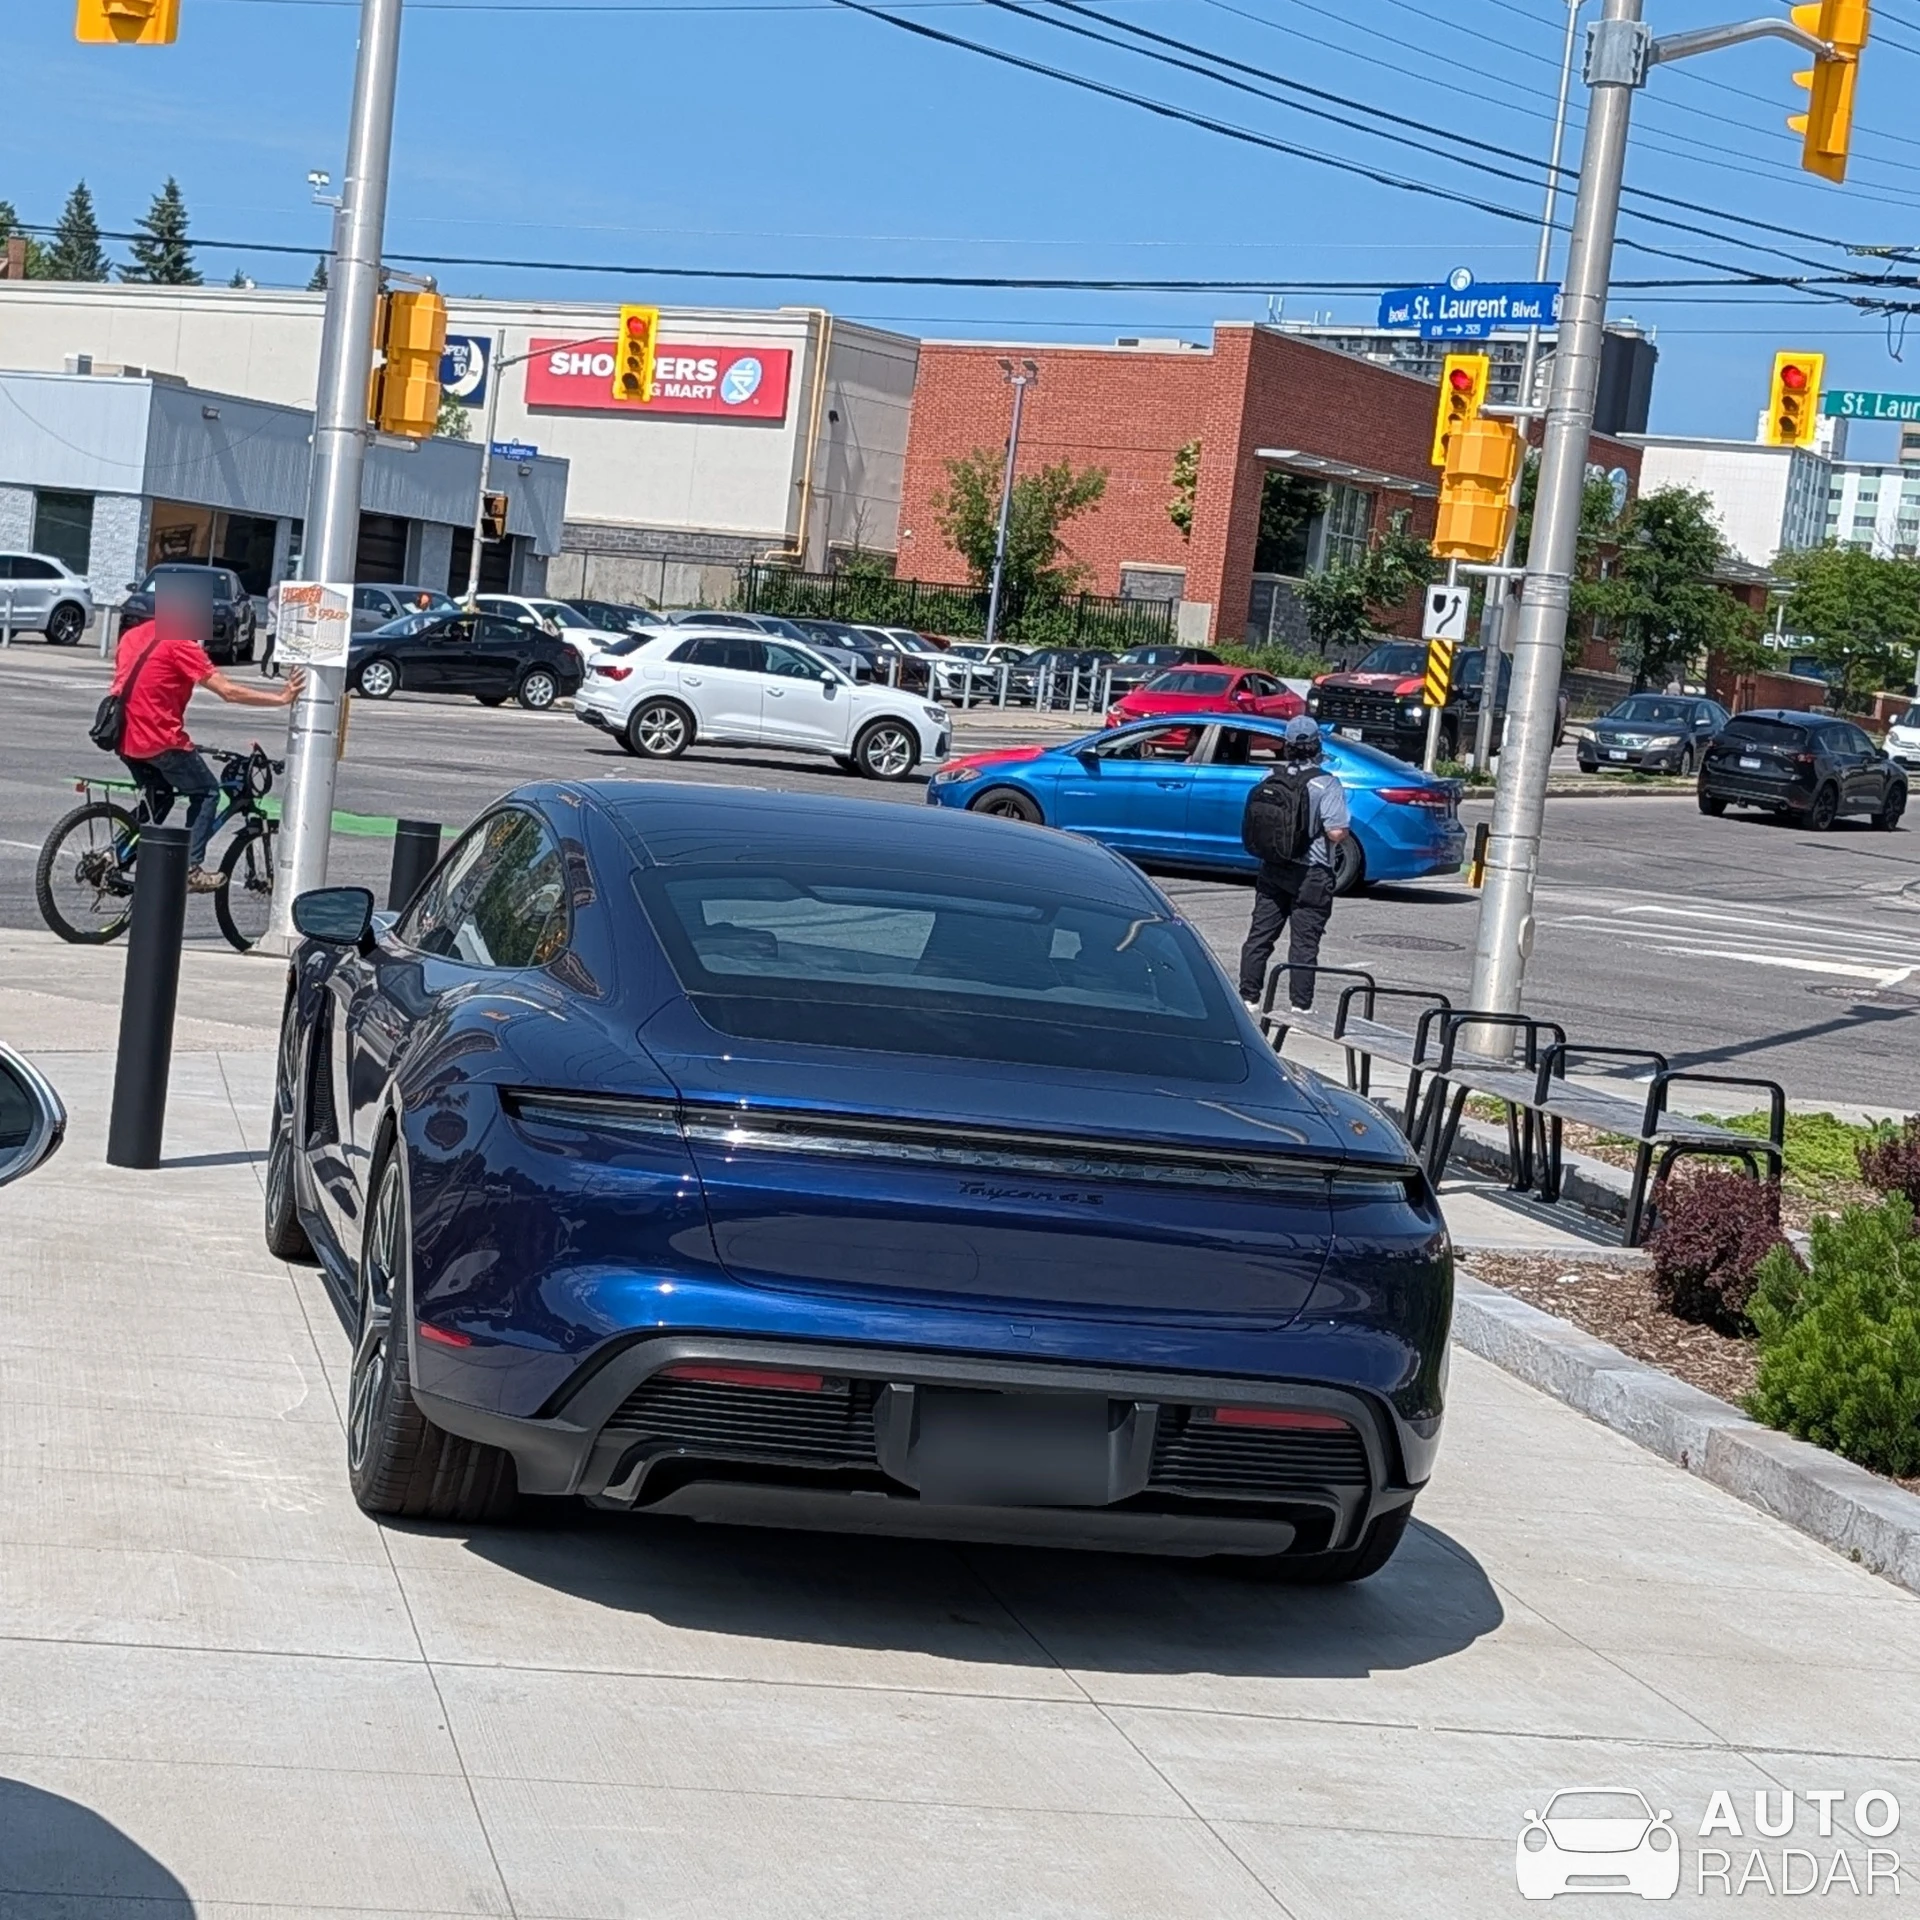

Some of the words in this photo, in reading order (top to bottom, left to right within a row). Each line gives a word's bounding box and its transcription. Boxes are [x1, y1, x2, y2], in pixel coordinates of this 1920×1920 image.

[1412, 295, 1434, 320] St.
[1439, 295, 1508, 319] Laurent
[1511, 300, 1542, 318] Blvd.
[453, 363, 467, 377] 10
[549, 351, 718, 382] SHOERS
[664, 384, 716, 399] MART
[1841, 392, 1870, 415] St.
[958, 1181, 1055, 1201] Taycan
